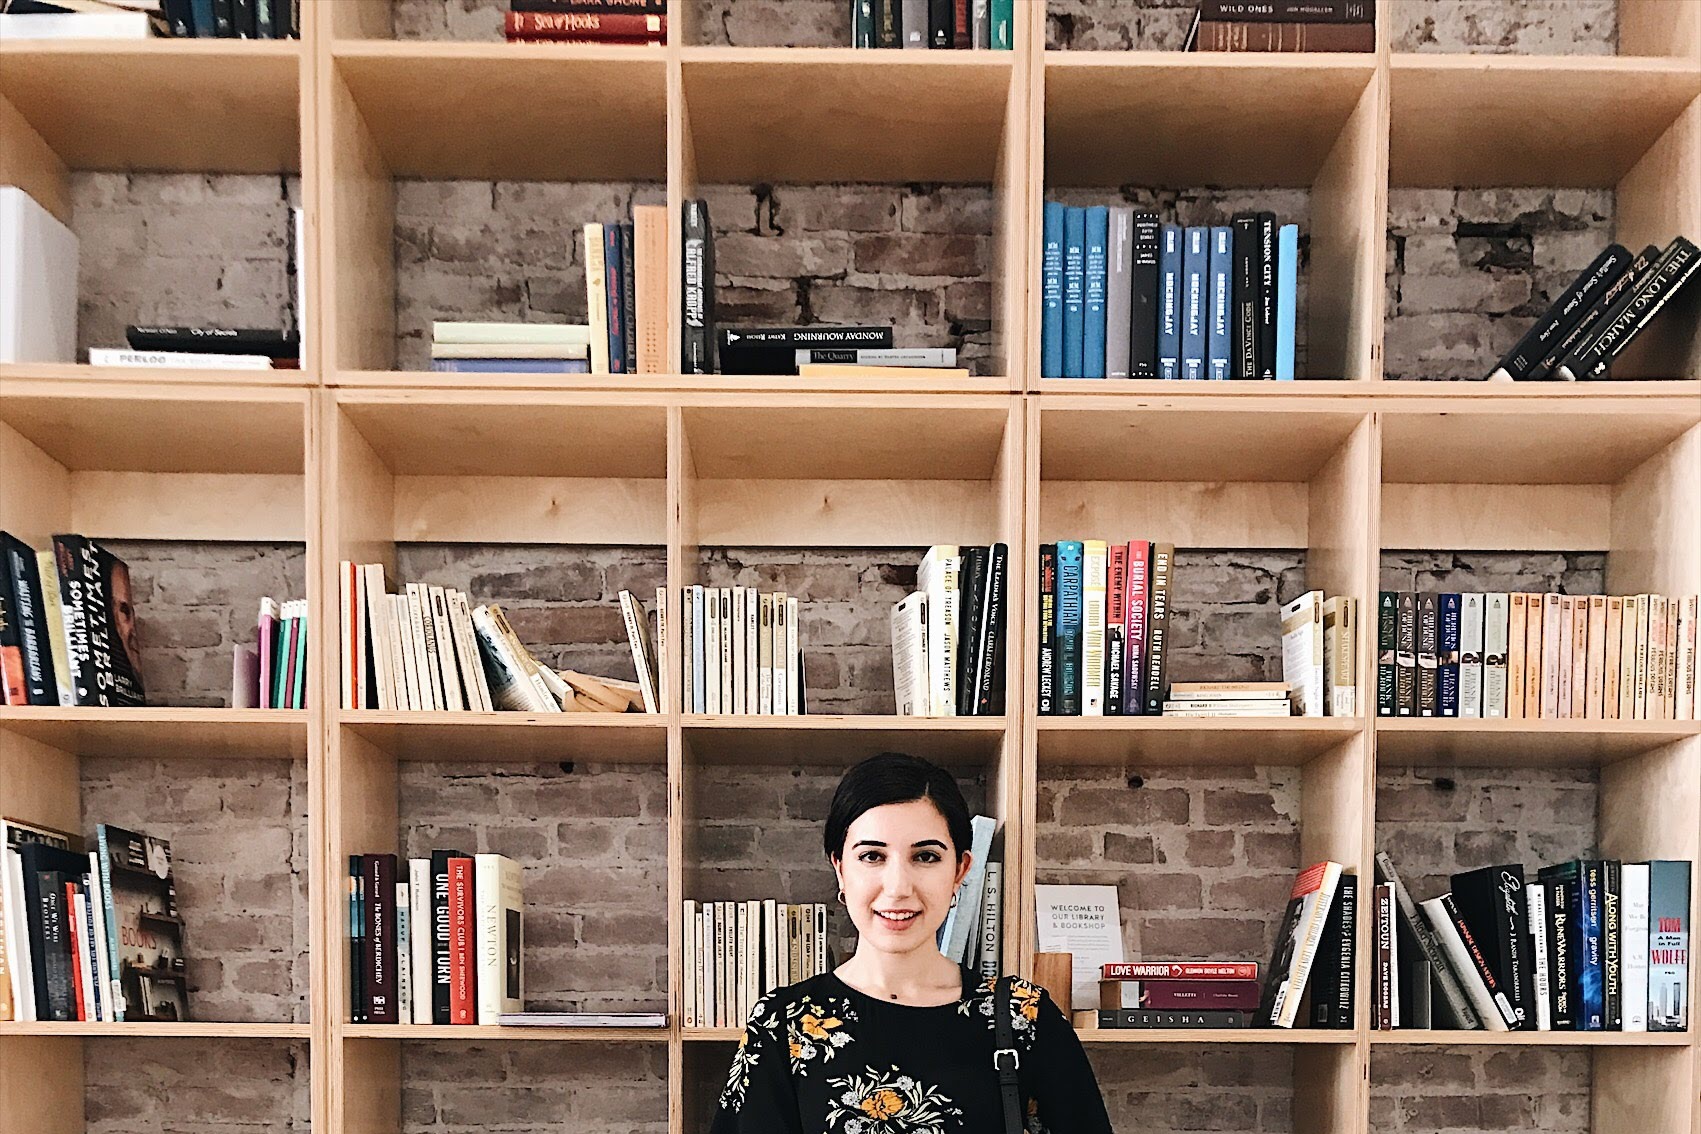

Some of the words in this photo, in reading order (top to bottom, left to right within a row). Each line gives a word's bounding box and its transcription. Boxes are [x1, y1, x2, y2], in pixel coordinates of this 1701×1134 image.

[1219, 5, 1244, 13] WILD
[1248, 5, 1274, 13] ONES
[1263, 220, 1272, 262] TENSION
[685, 250, 699, 284] ALFRED
[1262, 264, 1272, 287] CITY
[1664, 249, 1693, 276] THE
[685, 286, 699, 319] KROPP
[1165, 272, 1175, 336] MOCKINGJAY
[1190, 272, 1200, 336] MOCKINGJAY
[1216, 272, 1226, 336] MOCKINGJAY
[1634, 276, 1668, 310] LONG
[793, 331, 843, 342] MOURNING
[844, 331, 885, 341] MONDAY
[1592, 310, 1638, 357] MARCH
[119, 354, 167, 364] PERLOO
[813, 351, 830, 362] The
[830, 352, 856, 365] Quarry
[944, 558, 953, 583] PALACE
[995, 556, 1004, 571] THE
[1113, 552, 1123, 565] THE
[1156, 552, 1169, 573] END
[944, 586, 952, 594] OF
[1113, 567, 1123, 591] ENEMY
[1131, 560, 1145, 597] BURIAL
[1155, 575, 1167, 588] IN
[18, 580, 34, 618] WAITING
[1062, 565, 1080, 626] CARPATHIAN
[1112, 593, 1122, 619] WITHIN
[1153, 589, 1166, 621] TEARS
[69, 580, 90, 662] SOMETIMES
[944, 597, 952, 627] TREASON
[989, 604, 999, 626] VOICE
[1130, 600, 1144, 642] SOCIETY
[62, 605, 82, 679] BRILLIANT
[421, 616, 437, 654] CORIOLANUS
[944, 632, 952, 654] JASON
[1152, 629, 1163, 652] RUTH
[1427, 611, 1435, 651] CHILDREN
[25, 628, 43, 682] BARBARIANS
[1042, 648, 1053, 675] ANDREW
[1110, 641, 1121, 672] MICHAEL
[1131, 645, 1140, 660] NINA
[943, 656, 952, 692] MATTHEWS
[1041, 675, 1051, 698] LECKEY
[1109, 673, 1120, 700] SAVAGE
[1130, 660, 1140, 690] SADOWSKY
[1150, 654, 1162, 692] RENDELL
[1426, 673, 1434, 704] FRANK
[1448, 673, 1456, 703] FRANK
[98, 835, 106, 862] LIVING
[101, 862, 109, 886] WITH
[436, 873, 451, 900] ONE
[455, 866, 464, 880] THE
[987, 871, 997, 882] L.
[1590, 869, 1598, 888] tess
[104, 884, 113, 910] BOOKS
[456, 881, 466, 925] SURVIVORS
[987, 887, 996, 899] S.
[1343, 886, 1354, 899] THE
[42, 897, 52, 941] BROTHERS
[374, 902, 383, 913] The
[1050, 904, 1092, 912] WELCOME
[1094, 904, 1105, 912] TO
[1051, 912, 1069, 920] OUR
[1071, 912, 1105, 921] LIBRARY
[1342, 901, 1353, 930] SHADES
[1588, 888, 1600, 928] gerritsen
[1604, 892, 1619, 931] ALONG
[374, 912, 383, 937] BONES
[436, 905, 451, 941] GOOD
[458, 926, 466, 947] CLUB
[486, 904, 497, 968] NEWTON
[985, 903, 997, 953] HILTON
[1060, 922, 1106, 930] BOOKSHOP
[1380, 897, 1390, 950] ZEITOUN
[121, 925, 158, 950] BOOKS
[1589, 936, 1600, 966] gravity
[1608, 932, 1618, 959] WITH
[374, 944, 383, 985] BERDICHEV
[436, 949, 451, 985] TURN
[459, 952, 467, 964] BEN
[1340, 938, 1352, 969] EVGENIA
[1651, 949, 1687, 966] WOLFE
[459, 965, 468, 1000] SHERWOOD
[1110, 964, 1132, 977] LOVE
[1133, 964, 1170, 977] WARRIOR
[1604, 958, 1619, 996] YOUTH
[1339, 971, 1351, 1010] CITKOWITZ
[1127, 1015, 1205, 1024] GEISHA
